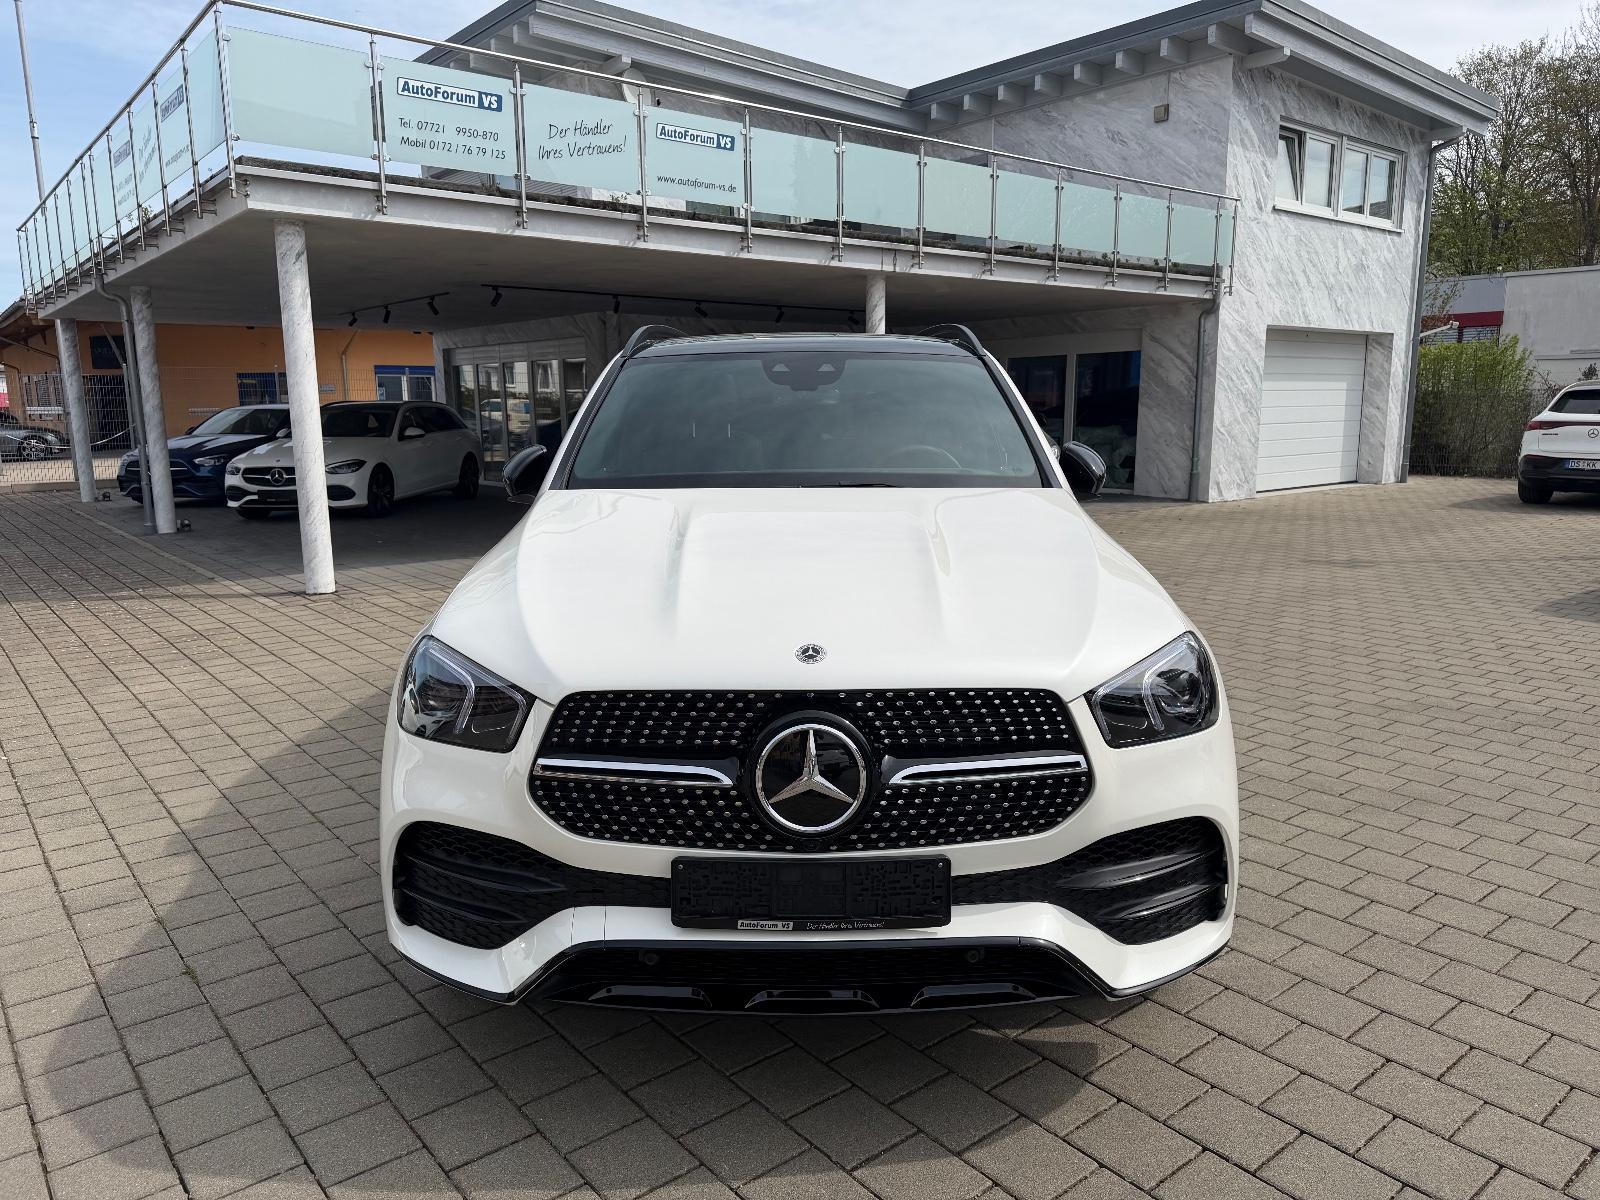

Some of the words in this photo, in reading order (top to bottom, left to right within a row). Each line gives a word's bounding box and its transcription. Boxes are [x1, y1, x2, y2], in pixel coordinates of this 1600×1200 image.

[400, 80, 477, 105] AutoForum
[481, 93, 498, 109] VS
[398, 117, 414, 129] Tel.
[416, 120, 445, 134] 07721
[455, 126, 499, 141] 9950-870
[548, 123, 570, 139] Der
[574, 118, 613, 136] Händler
[659, 125, 716, 146] AutoForum
[719, 135, 732, 149] VS
[400, 136, 427, 149] Mobil
[429, 139, 453, 152] 0172
[462, 144, 473, 155] 76
[476, 146, 487, 157] 79
[490, 148, 506, 160] 125
[538, 145, 563, 160] Ihres
[567, 134, 627, 157] Vertrauens!
[656, 175, 737, 193] www.autoforum-vs.de
[739, 921, 779, 930] AutoForum
[781, 922, 791, 930] VS
